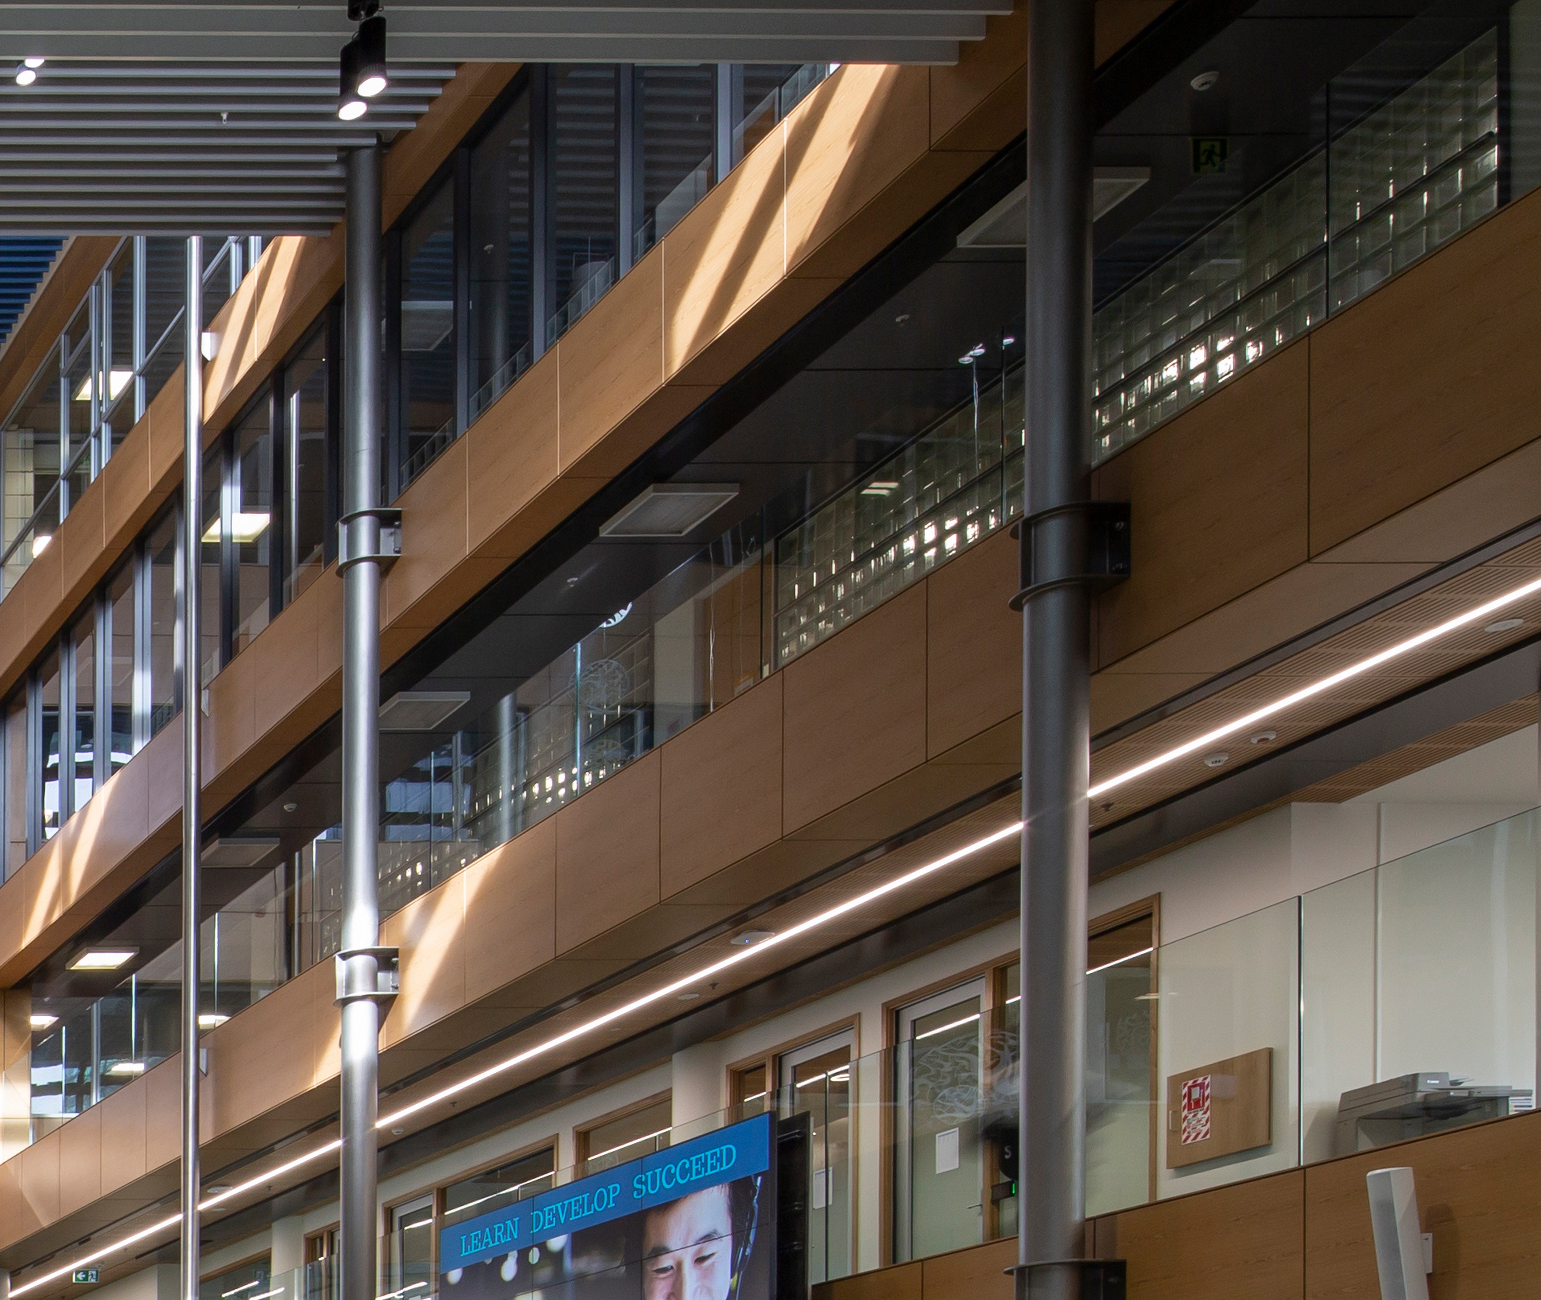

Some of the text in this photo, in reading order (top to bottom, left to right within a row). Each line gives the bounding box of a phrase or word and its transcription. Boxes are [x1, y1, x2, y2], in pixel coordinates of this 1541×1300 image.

[460, 1144, 736, 1256] LEARN DEVELOP SUCCEED
